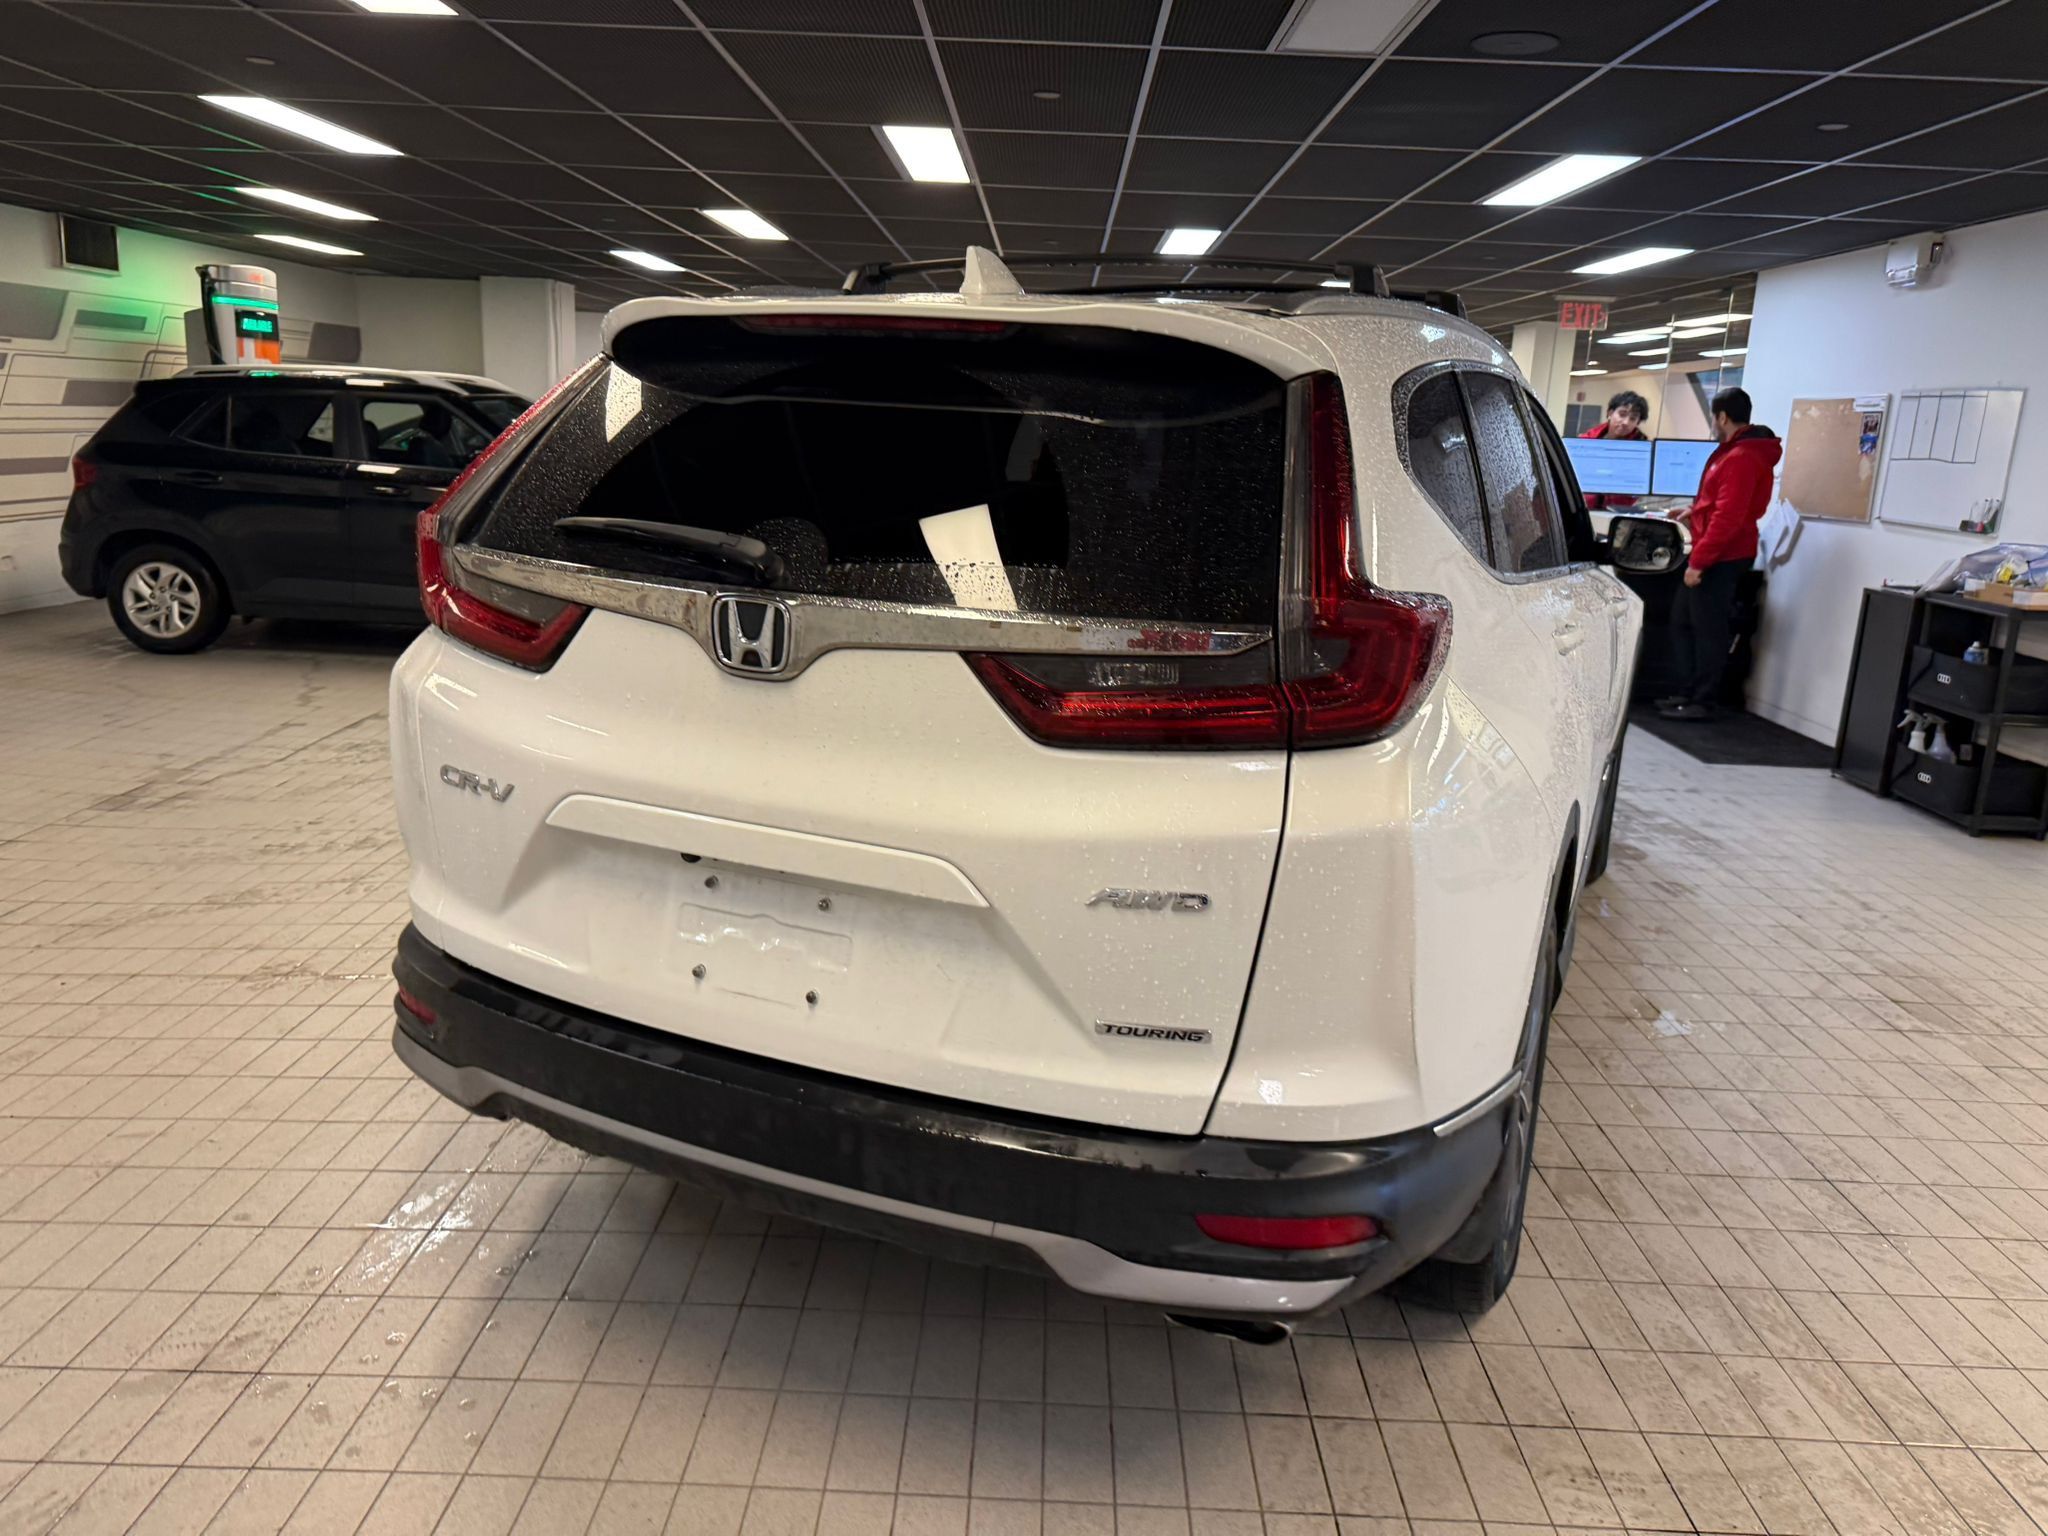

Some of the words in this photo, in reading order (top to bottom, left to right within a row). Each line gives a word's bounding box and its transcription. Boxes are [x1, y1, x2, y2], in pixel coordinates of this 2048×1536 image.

[1560, 303, 1602, 329] EXIT
[440, 764, 515, 803] CR-V
[1085, 887, 1210, 913] AWD
[1102, 1023, 1206, 1042] TOURING
